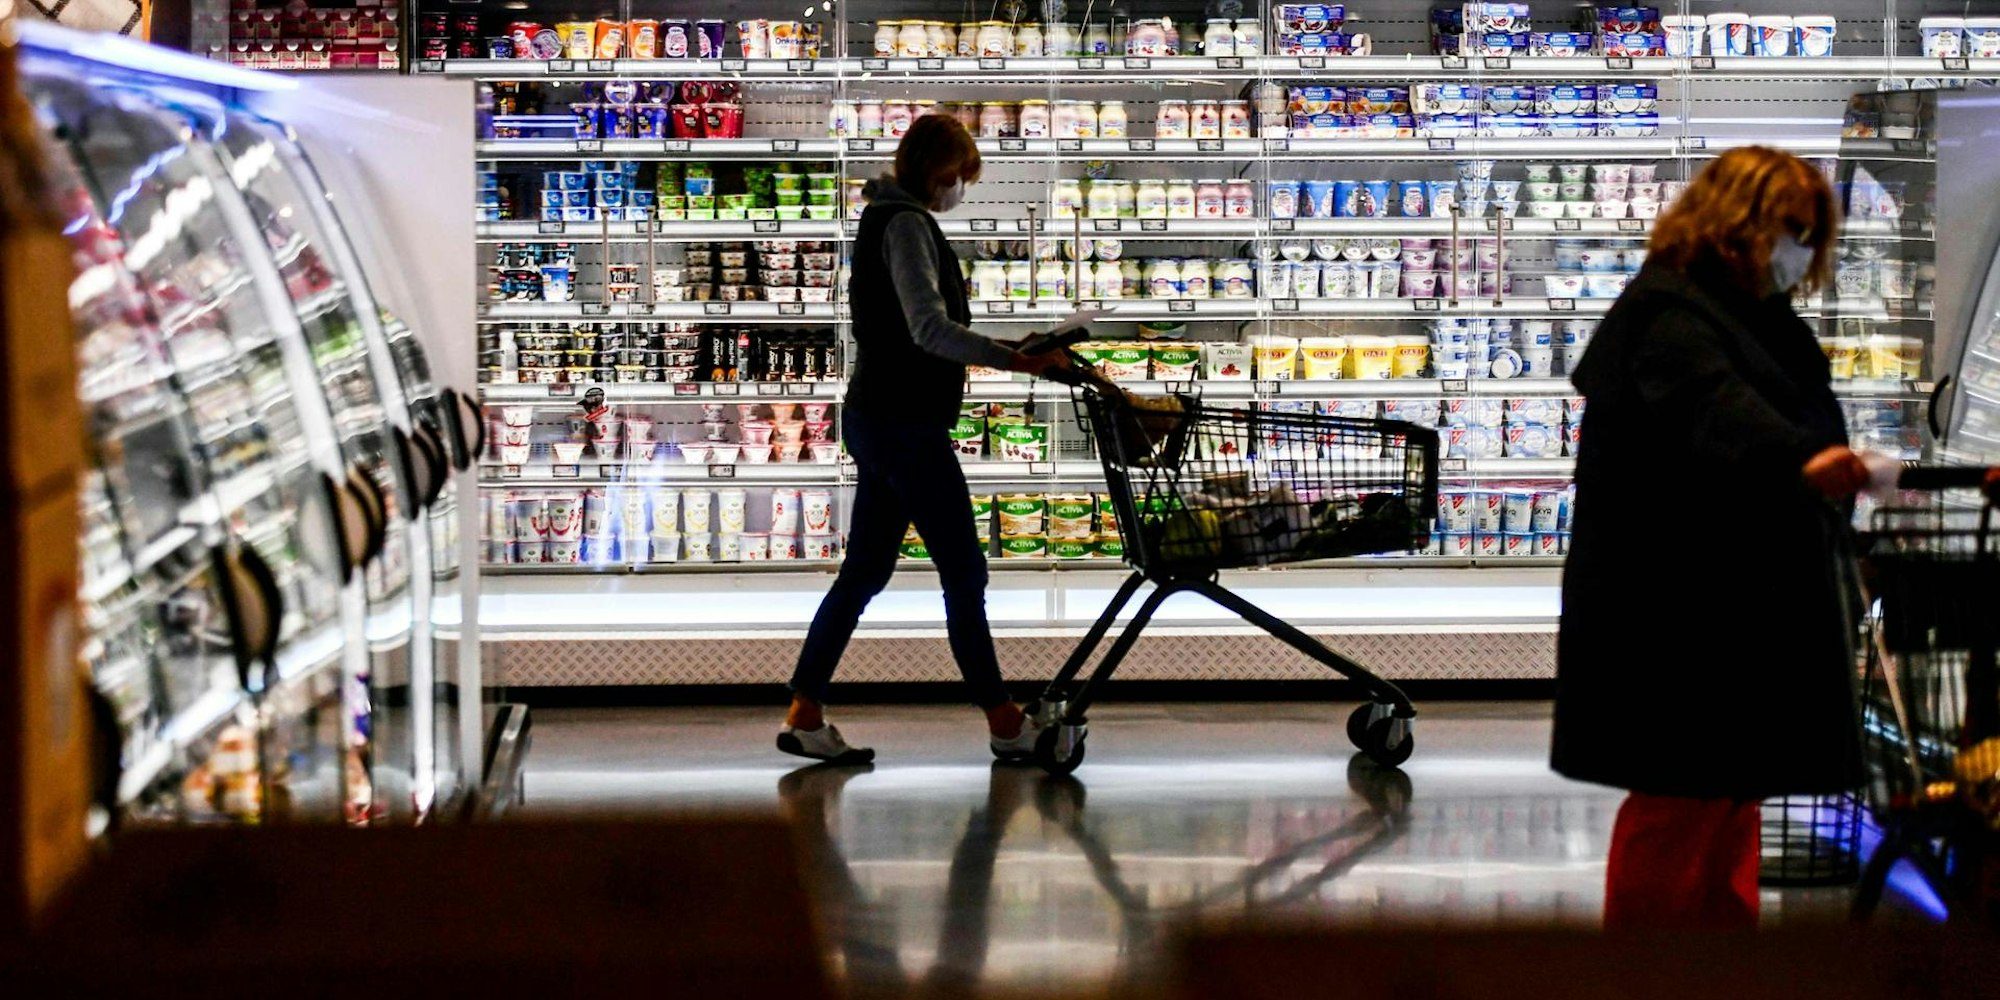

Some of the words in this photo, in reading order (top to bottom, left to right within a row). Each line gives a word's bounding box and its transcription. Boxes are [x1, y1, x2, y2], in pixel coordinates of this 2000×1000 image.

[1112, 352, 1140, 360] ACTIVIA
[1162, 352, 1190, 360] ACTIVIA
[1217, 348, 1242, 356] ACTIVIA
[1006, 429, 1033, 439] ACTIVIA
[1006, 502, 1034, 511] ACTIVIA
[1056, 505, 1084, 514] ACTIVIA
[1533, 507, 1552, 515] SKYR
[1009, 540, 1037, 549] ACTIVIA
[1056, 544, 1084, 553] ACTIVIA
